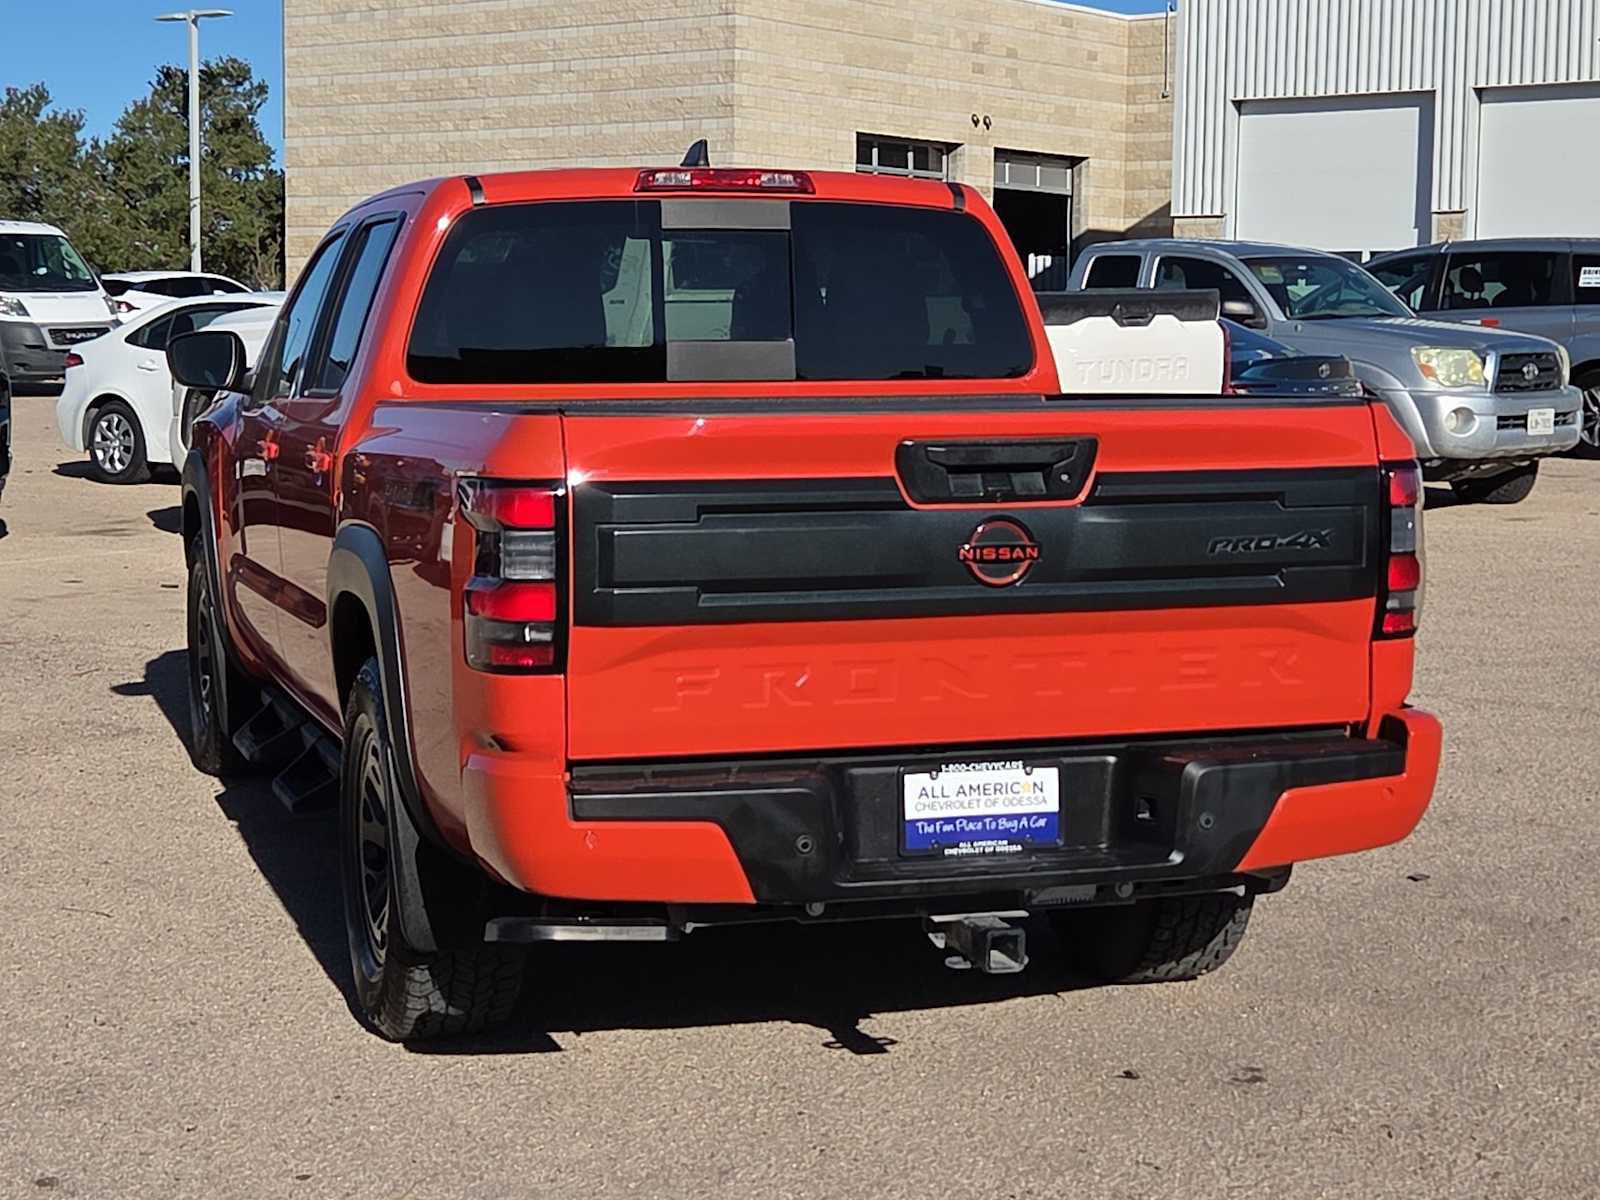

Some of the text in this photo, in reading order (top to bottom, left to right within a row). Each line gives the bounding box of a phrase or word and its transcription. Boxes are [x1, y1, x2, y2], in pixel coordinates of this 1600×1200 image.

[1073, 355, 1191, 385] TUNDRA
[959, 547, 1038, 560] NISSAN
[652, 642, 1305, 712] FRONTIER
[918, 786, 950, 799] ALL
[915, 796, 1048, 812] CHEVROLET OF ODESSA
[916, 821, 935, 835] The
[956, 818, 983, 831] Place
[984, 818, 997, 831] To
[999, 817, 1019, 832] Buy
[1019, 816, 1028, 829] A
[1030, 815, 1048, 828] Car
